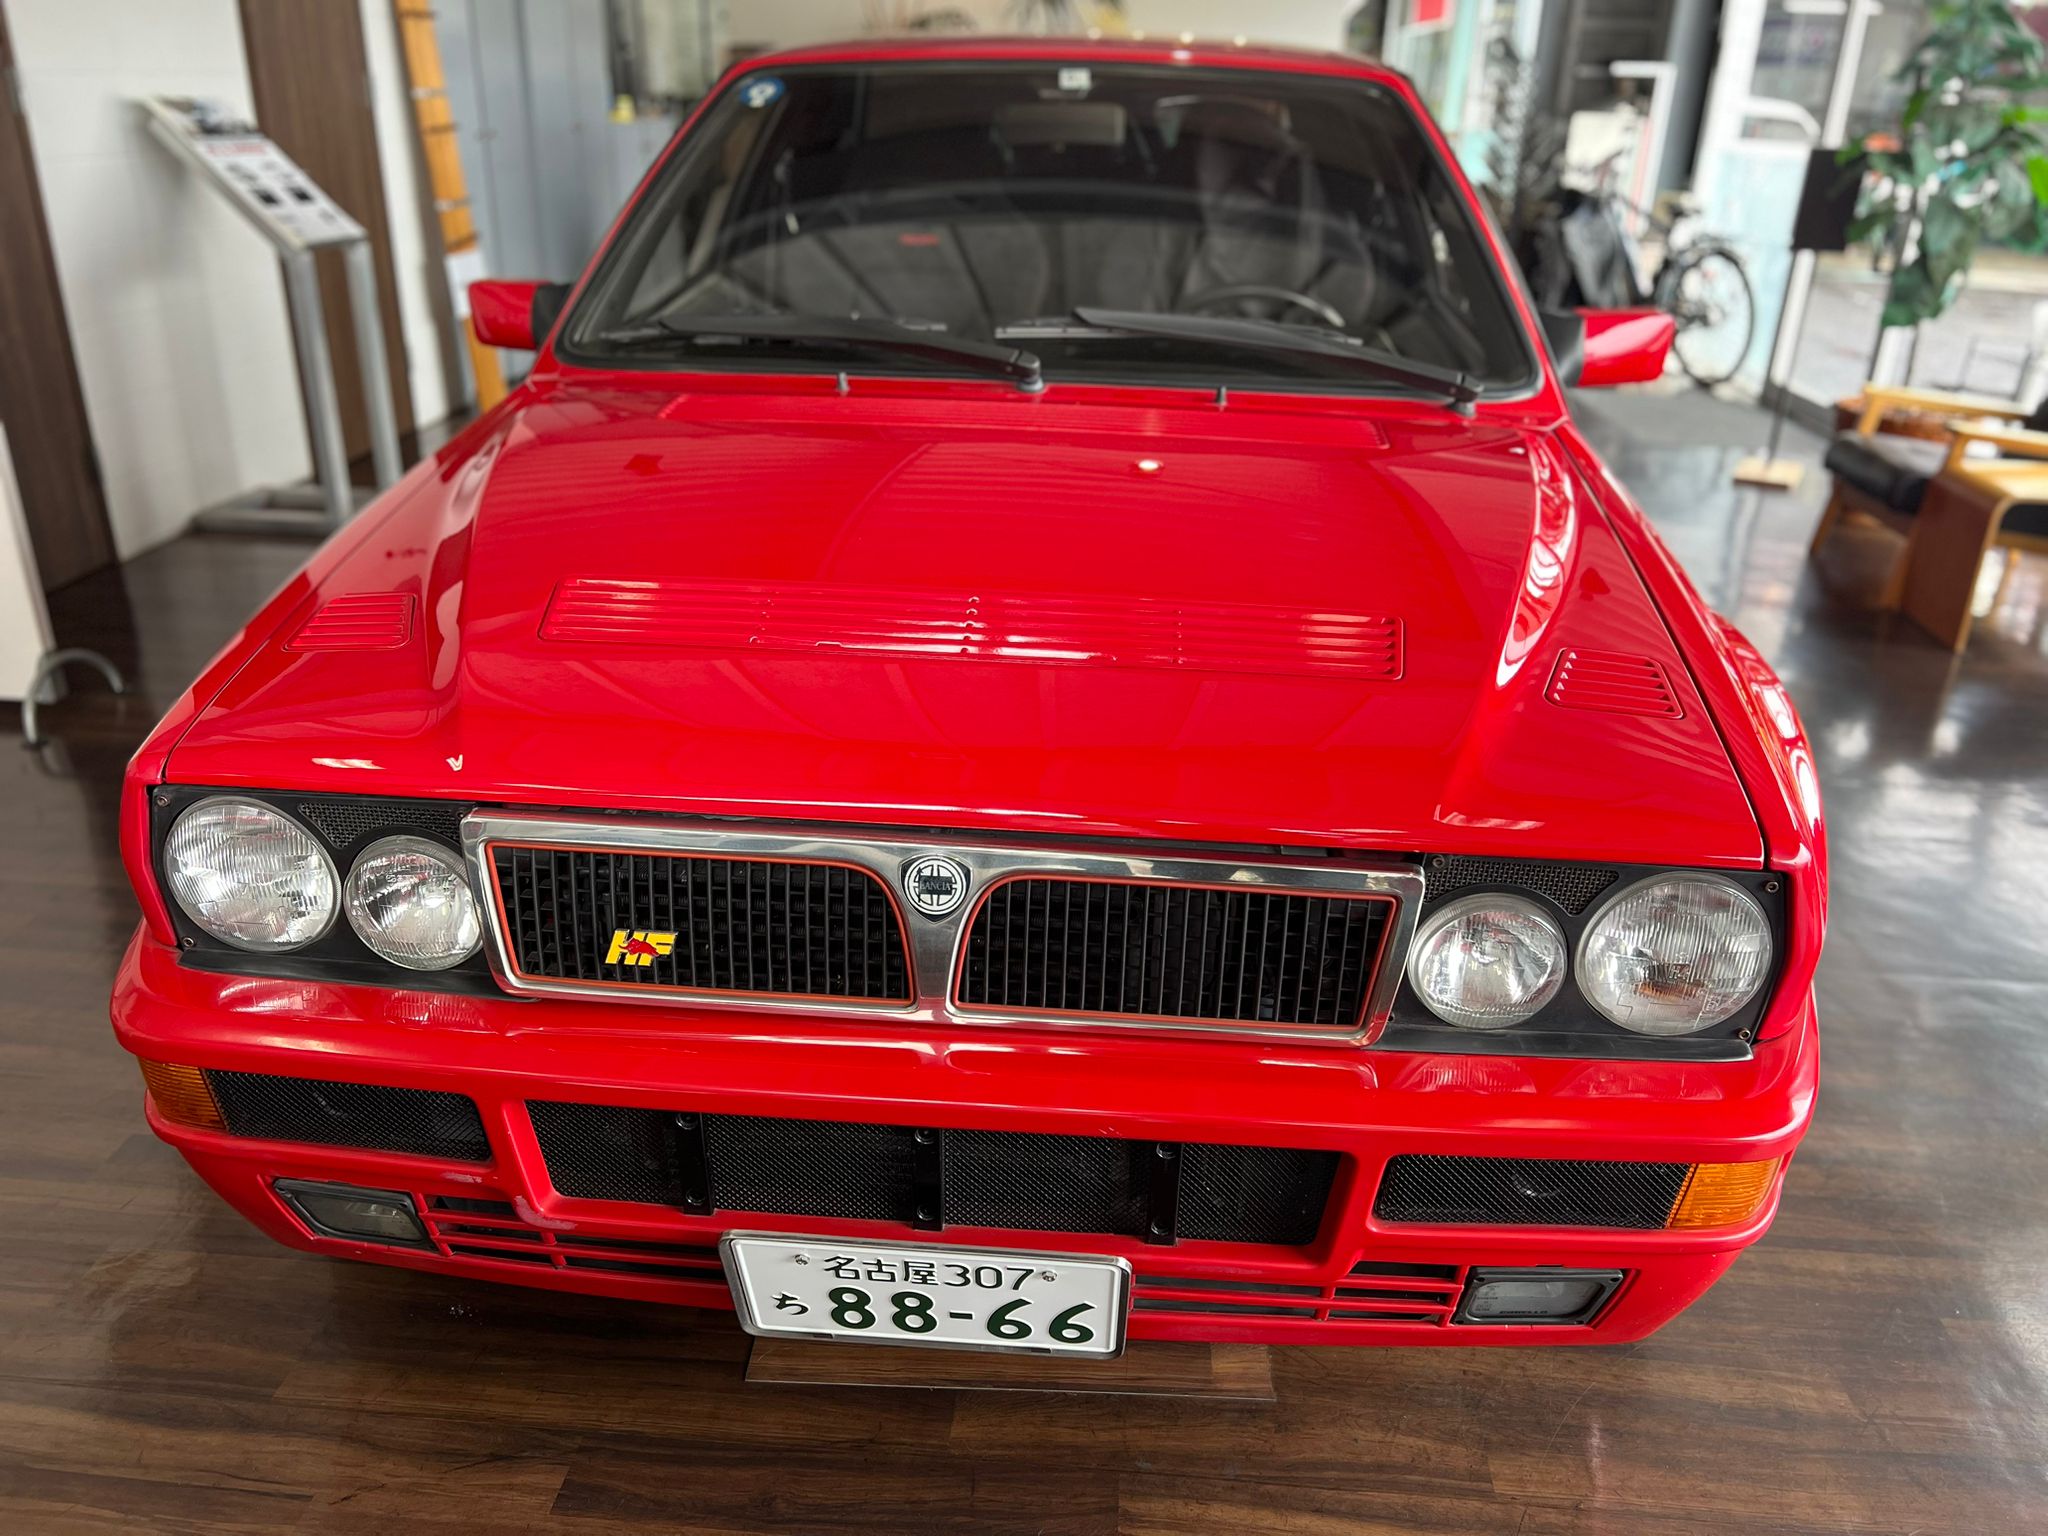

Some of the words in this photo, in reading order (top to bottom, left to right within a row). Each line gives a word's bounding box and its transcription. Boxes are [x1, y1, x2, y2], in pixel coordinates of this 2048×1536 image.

[919, 880, 951, 891] LANCIA
[604, 928, 678, 967] HF
[771, 1291, 809, 1316] ち
[828, 1286, 1095, 1344] 88-66
